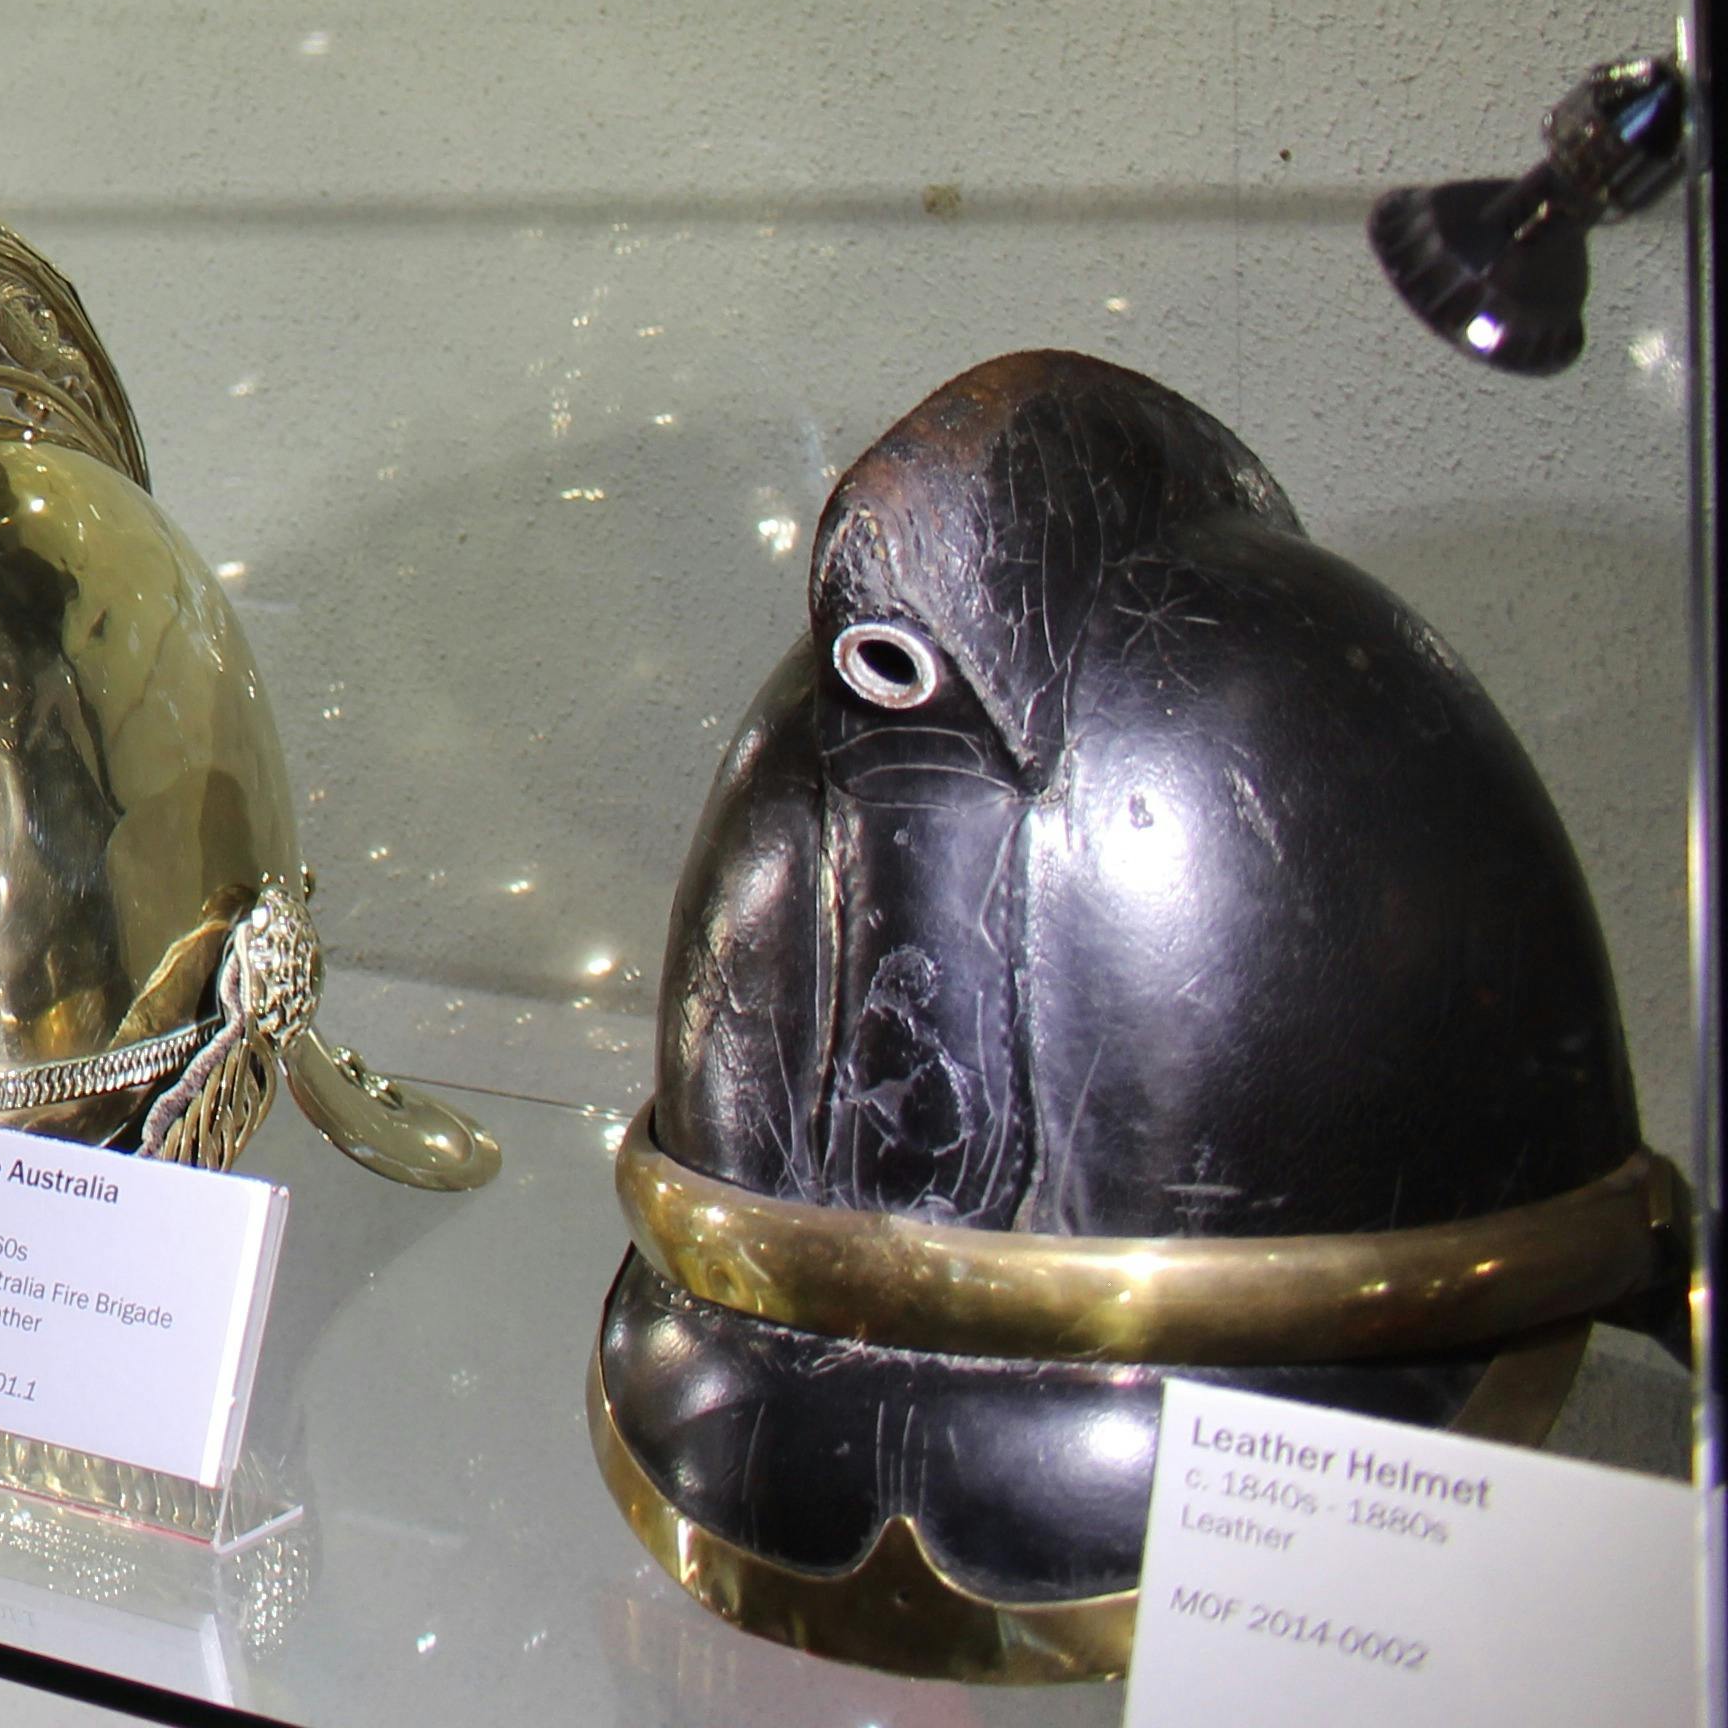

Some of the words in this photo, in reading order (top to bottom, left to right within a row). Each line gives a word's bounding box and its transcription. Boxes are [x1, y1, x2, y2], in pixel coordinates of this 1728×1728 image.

[7, 1158, 119, 1204] Australia
[52, 1283, 89, 1310] Fire
[95, 1292, 173, 1330] Brigade
[1191, 1416, 1336, 1474] Leather
[1346, 1447, 1492, 1510] Helmet
[1180, 1504, 1296, 1552] Leather
[1184, 1469, 1208, 1493] c.
[1221, 1470, 1319, 1517] 1840s
[1348, 1498, 1448, 1546] 1880s
[1170, 1586, 1244, 1623] MOF
[1247, 1604, 1429, 1670] 2014-0002
